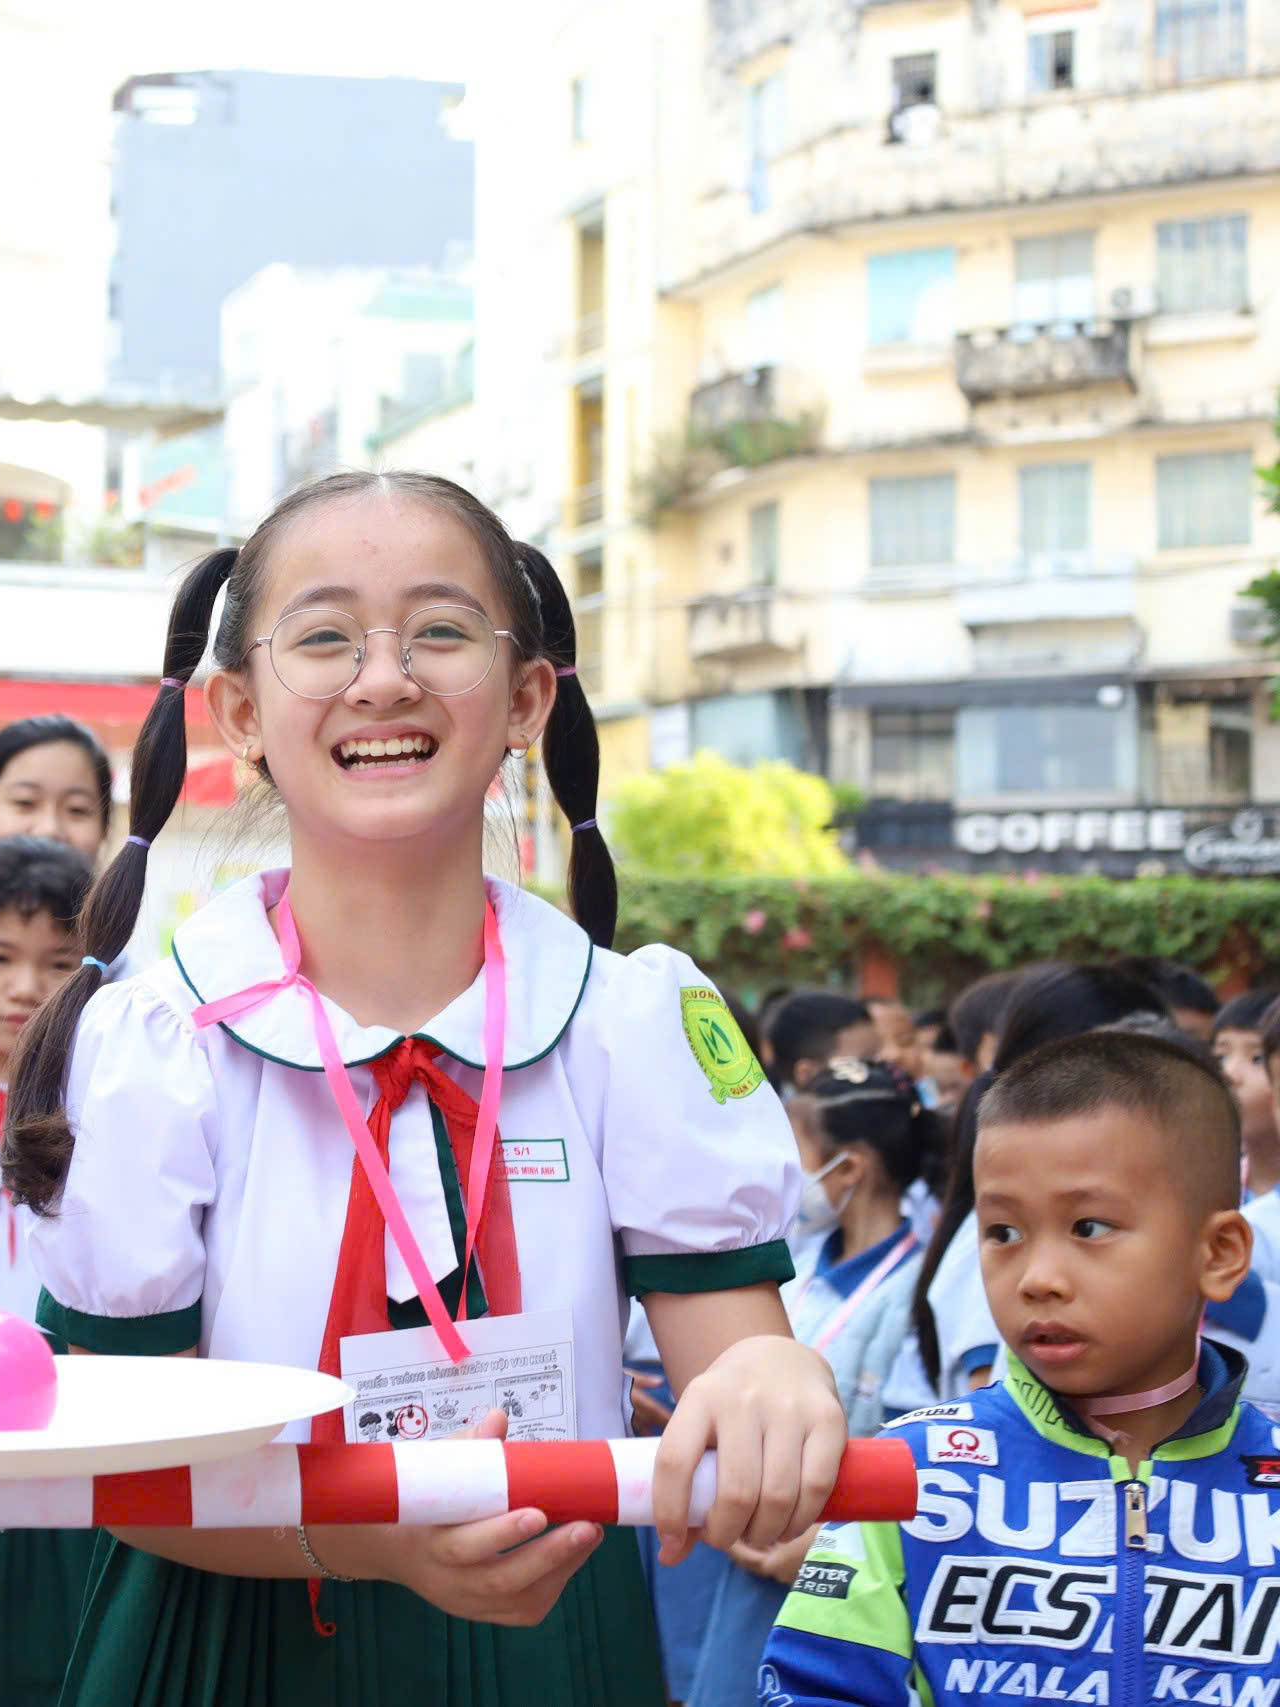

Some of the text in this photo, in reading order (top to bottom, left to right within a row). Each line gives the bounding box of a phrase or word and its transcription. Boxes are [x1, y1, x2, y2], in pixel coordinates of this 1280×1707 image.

[956, 810, 1185, 853] COFFEE
[513, 1146, 531, 1156] 5/1
[521, 1166, 539, 1175] MINH
[541, 1166, 555, 1175] ANH
[357, 1374, 388, 1391] PHIẾU
[510, 1356, 529, 1368] VUI
[928, 1564, 1280, 1657] ECSTA
[944, 1658, 1110, 1706] NYALA
